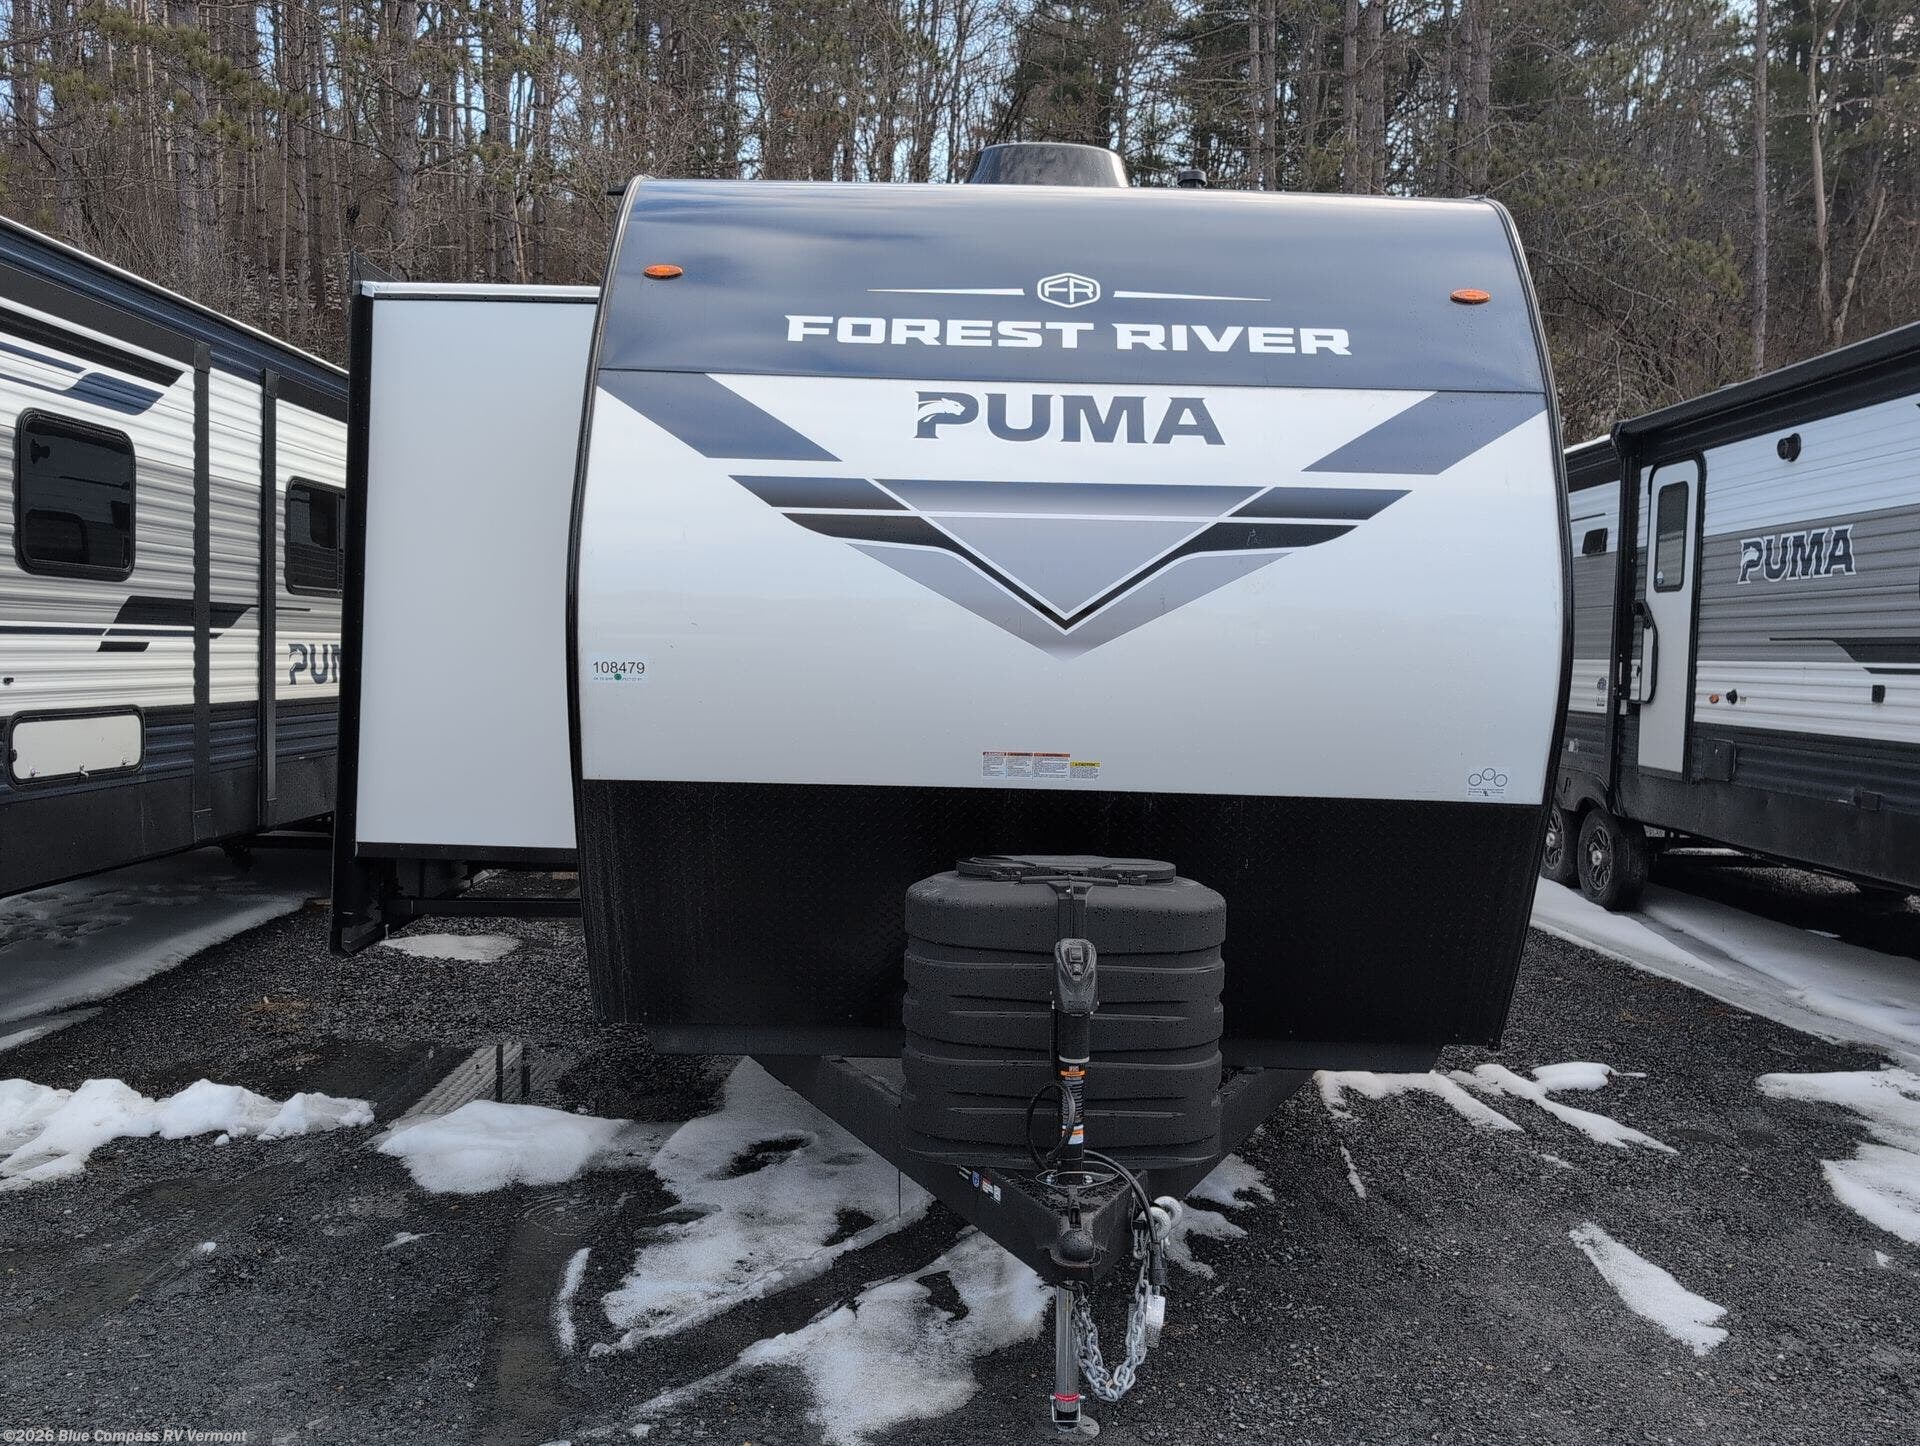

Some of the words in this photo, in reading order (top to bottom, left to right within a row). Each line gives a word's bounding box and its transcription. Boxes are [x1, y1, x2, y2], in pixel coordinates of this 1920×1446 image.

[784, 314, 1094, 349] FOREST
[1111, 321, 1353, 356] RIVER
[915, 391, 1226, 446] PUMA
[1738, 525, 1856, 584] PUMA
[592, 661, 645, 674] 108479
